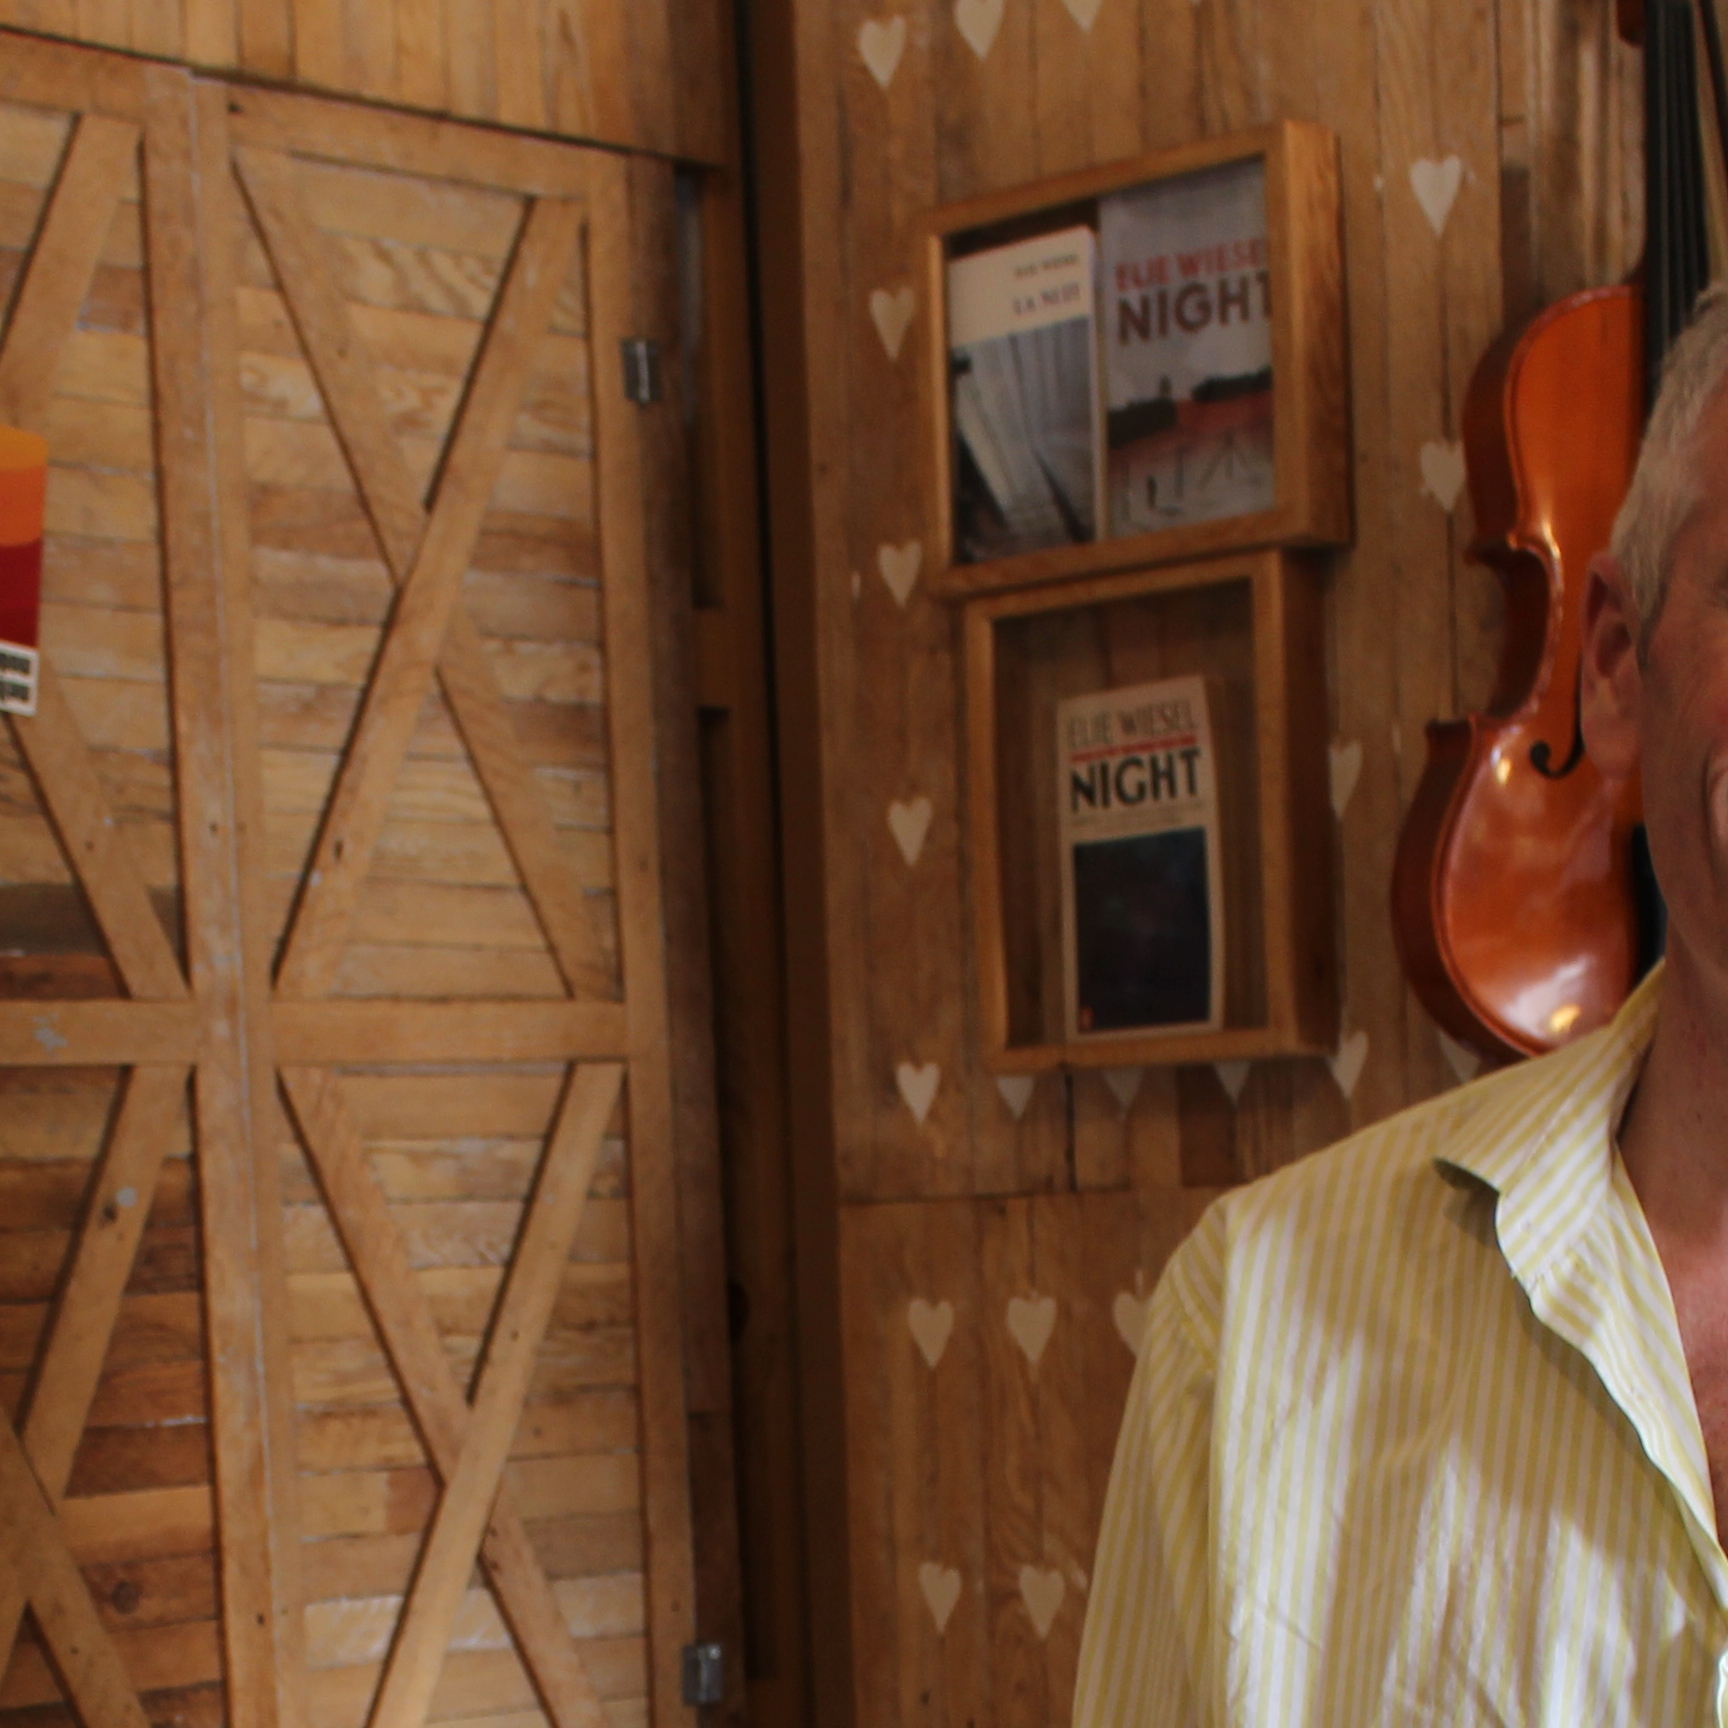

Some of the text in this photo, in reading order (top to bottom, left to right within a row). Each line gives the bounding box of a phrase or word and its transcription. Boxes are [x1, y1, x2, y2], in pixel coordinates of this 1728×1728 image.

[1175, 239, 1270, 277] WIESE
[1118, 270, 1271, 345] NIGHT
[1069, 745, 1202, 815] NIGHT
